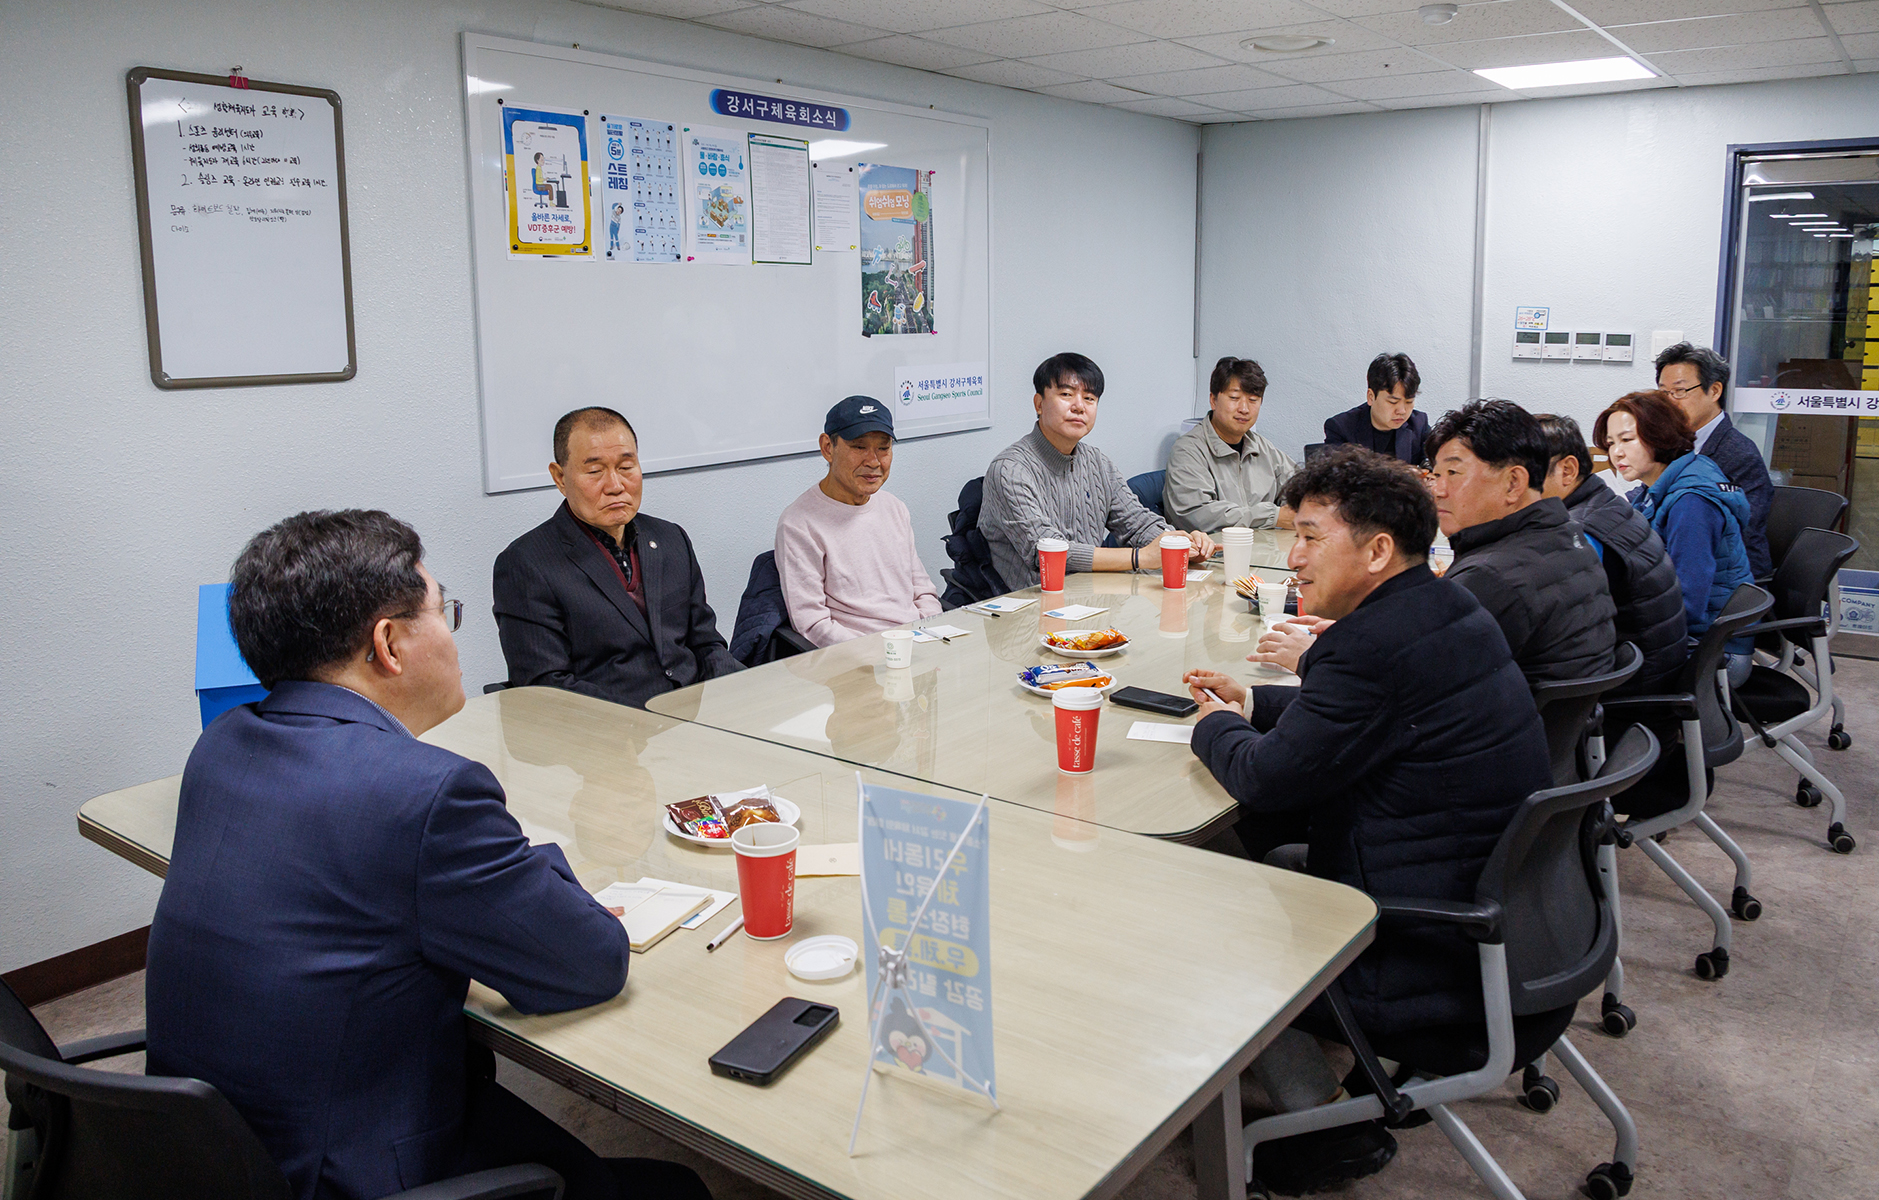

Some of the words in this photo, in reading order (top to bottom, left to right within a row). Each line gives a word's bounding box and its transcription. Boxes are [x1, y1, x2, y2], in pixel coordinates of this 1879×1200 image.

[727, 95, 837, 128] 강서구체육회소식
[869, 194, 895, 209] 쉬엄쉬엄
[895, 194, 910, 209] 모닝
[531, 212, 551, 222] 올바른
[551, 213, 573, 224] 자세로,
[527, 223, 560, 234] VDT증후군
[560, 225, 577, 234] 예방!
[917, 378, 948, 391] 서울특별시
[949, 375, 983, 389] 강서구체육회
[917, 393, 931, 402] Seoul
[931, 391, 951, 402] Gangseo
[951, 389, 967, 400] Sports
[967, 387, 983, 397] Council
[1797, 395, 1861, 409] 서울특별시
[1841, 597, 1876, 608] COMPANY
[1071, 715, 1082, 734] café
[1071, 734, 1081, 746] de
[1072, 746, 1081, 768] tasse
[785, 857, 794, 881] café
[784, 882, 793, 897] de
[784, 898, 792, 928] tasse
